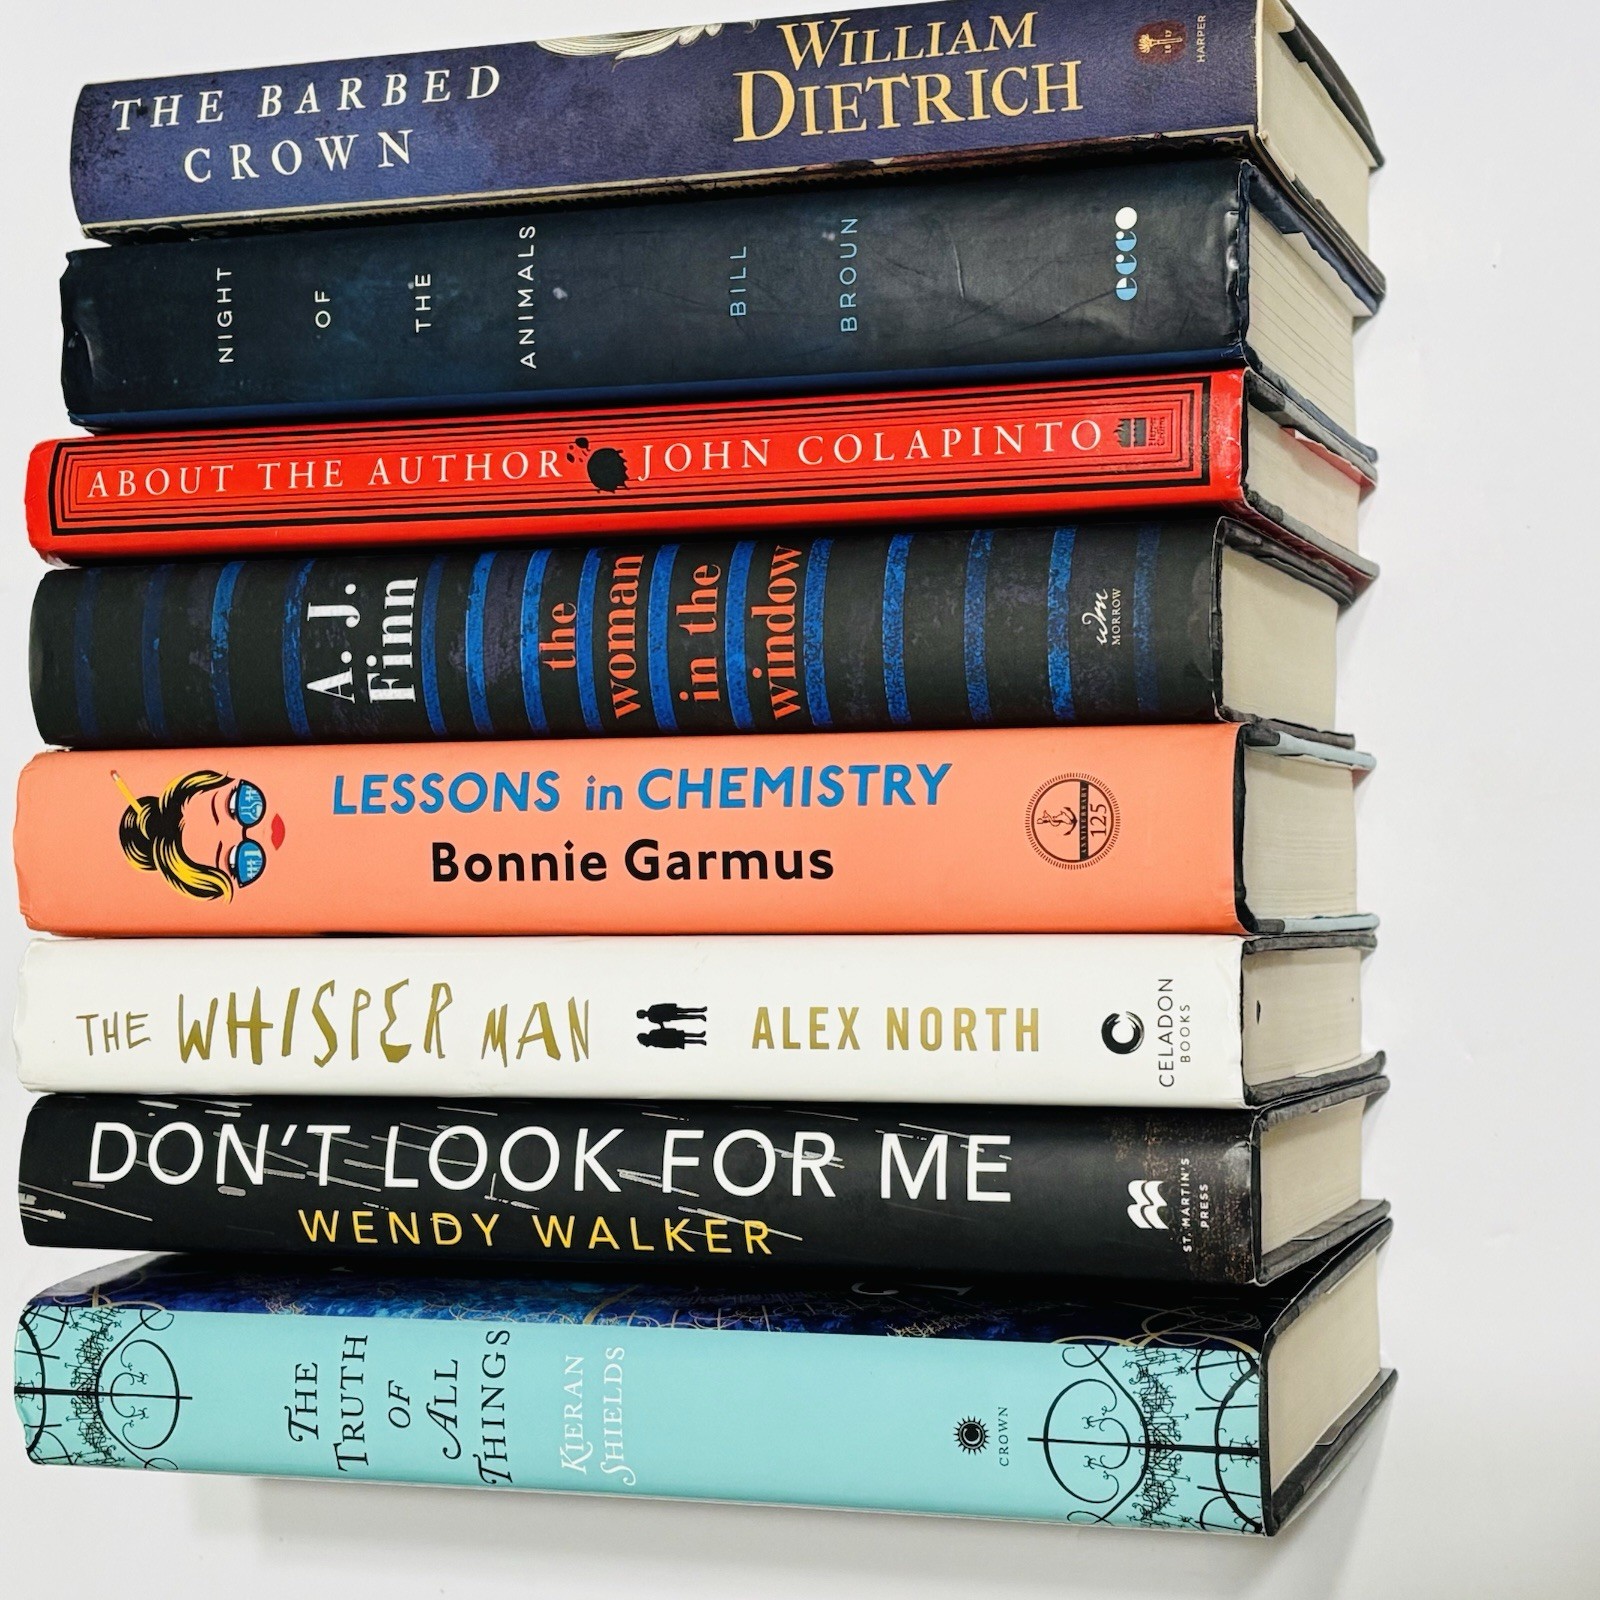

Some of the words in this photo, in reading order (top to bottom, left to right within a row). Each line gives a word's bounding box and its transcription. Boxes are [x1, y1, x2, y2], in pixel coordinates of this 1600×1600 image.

[777, 11, 1039, 71] WILLIAM
[1196, 15, 1207, 63] HARPER
[112, 91, 224, 132] THE
[257, 64, 500, 118] BARBED
[733, 60, 1084, 143] DIETRICH
[184, 129, 414, 183] CROWN
[415, 272, 432, 333] THE
[518, 225, 537, 369] ANIMALS
[729, 246, 747, 317] BILL
[839, 218, 859, 333] BROUN
[216, 267, 234, 363] NIGHT
[314, 290, 331, 328] OF
[87, 464, 235, 499] ABOUT
[257, 459, 344, 491] THE
[367, 449, 563, 485] AUTHOR
[638, 438, 773, 482] JOHN
[798, 419, 1102, 465] COLAPINTO
[306, 582, 361, 628] J.
[676, 563, 722, 635] the
[1111, 587, 1122, 646] MORROW
[366, 577, 420, 703] Finn
[539, 601, 578, 672] the
[607, 554, 645, 719] woman
[751, 545, 802, 720] window
[306, 650, 356, 704] A.
[679, 652, 721, 702] in
[333, 770, 560, 815] LESSONS
[585, 775, 623, 811] in
[637, 763, 952, 811] CHEMISTRY
[1090, 803, 1108, 837] 125
[432, 839, 607, 883] Bonnie
[624, 838, 834, 881] Garmus
[76, 1012, 152, 1057] THE
[178, 978, 453, 1068] WHISPER
[481, 997, 590, 1068] MAN
[751, 1006, 861, 1051] ALEX
[886, 1006, 1040, 1052] NORTH
[1158, 977, 1175, 1089] CELADON
[1179, 1003, 1191, 1064] BOOKS
[89, 1121, 351, 1186] DON'T
[384, 1125, 625, 1192] LOOK
[662, 1128, 836, 1198] FOR
[880, 1132, 1012, 1202] ME
[1180, 1157, 1191, 1228] MARTIN'S
[298, 1209, 500, 1247] WENDY
[531, 1214, 772, 1255] WALKER
[1199, 1183, 1210, 1229] PRESS
[1181, 1232, 1192, 1253] ST.
[284, 1361, 319, 1445] THE
[337, 1334, 369, 1472] TRUTH
[387, 1379, 412, 1430] OF
[426, 1359, 461, 1460] ALL
[471, 1329, 514, 1485] THINGS
[560, 1354, 593, 1475] KIERAN
[600, 1345, 637, 1487] SHIELDS
[997, 1406, 1010, 1468] CROWN
